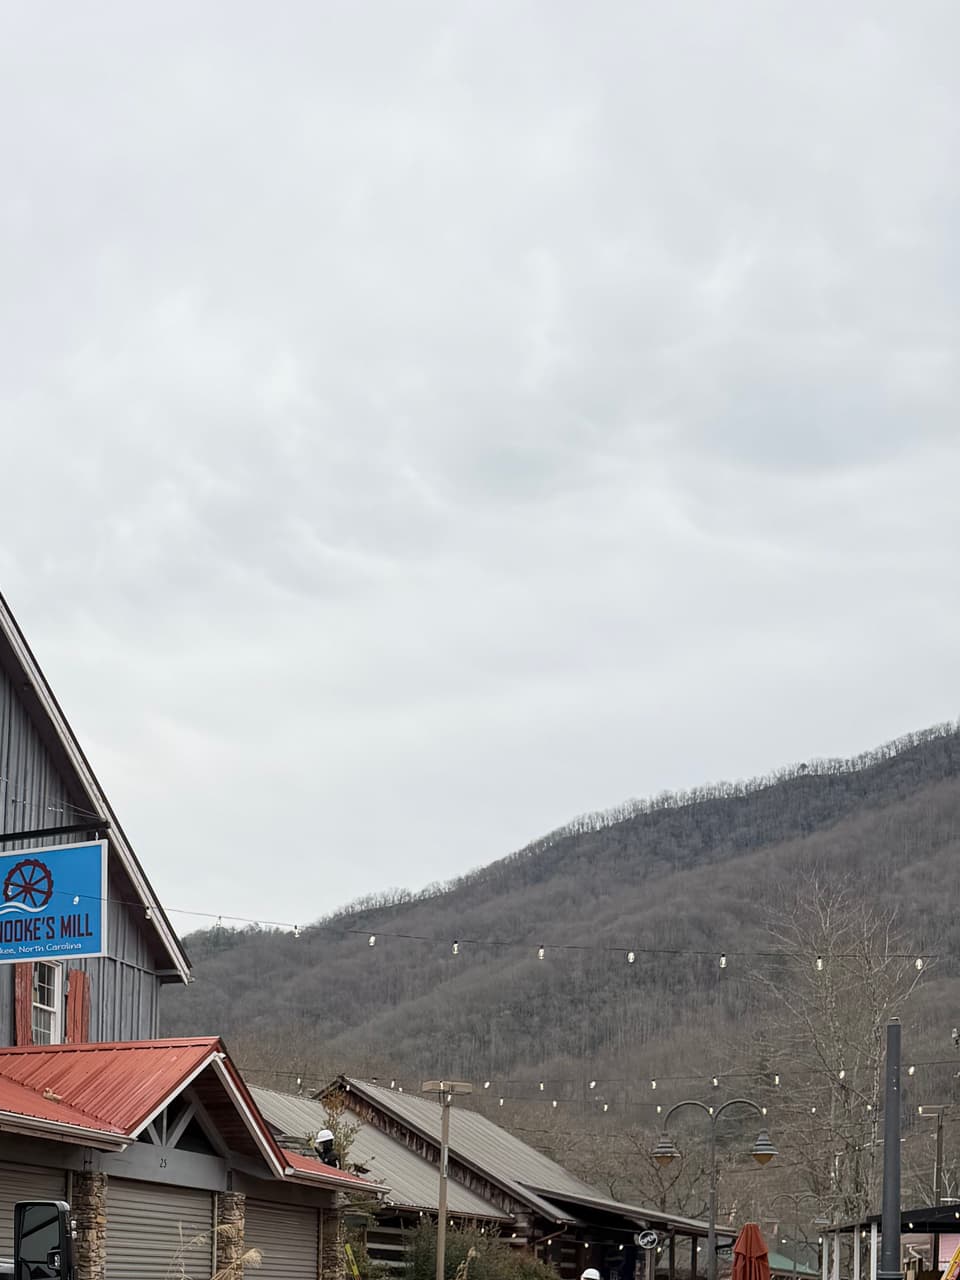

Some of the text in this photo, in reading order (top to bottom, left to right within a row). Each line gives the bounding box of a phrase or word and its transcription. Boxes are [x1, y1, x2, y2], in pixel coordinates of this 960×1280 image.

[60, 913, 93, 939] MILL
[18, 944, 44, 954] North
[46, 941, 82, 952] Carolina
